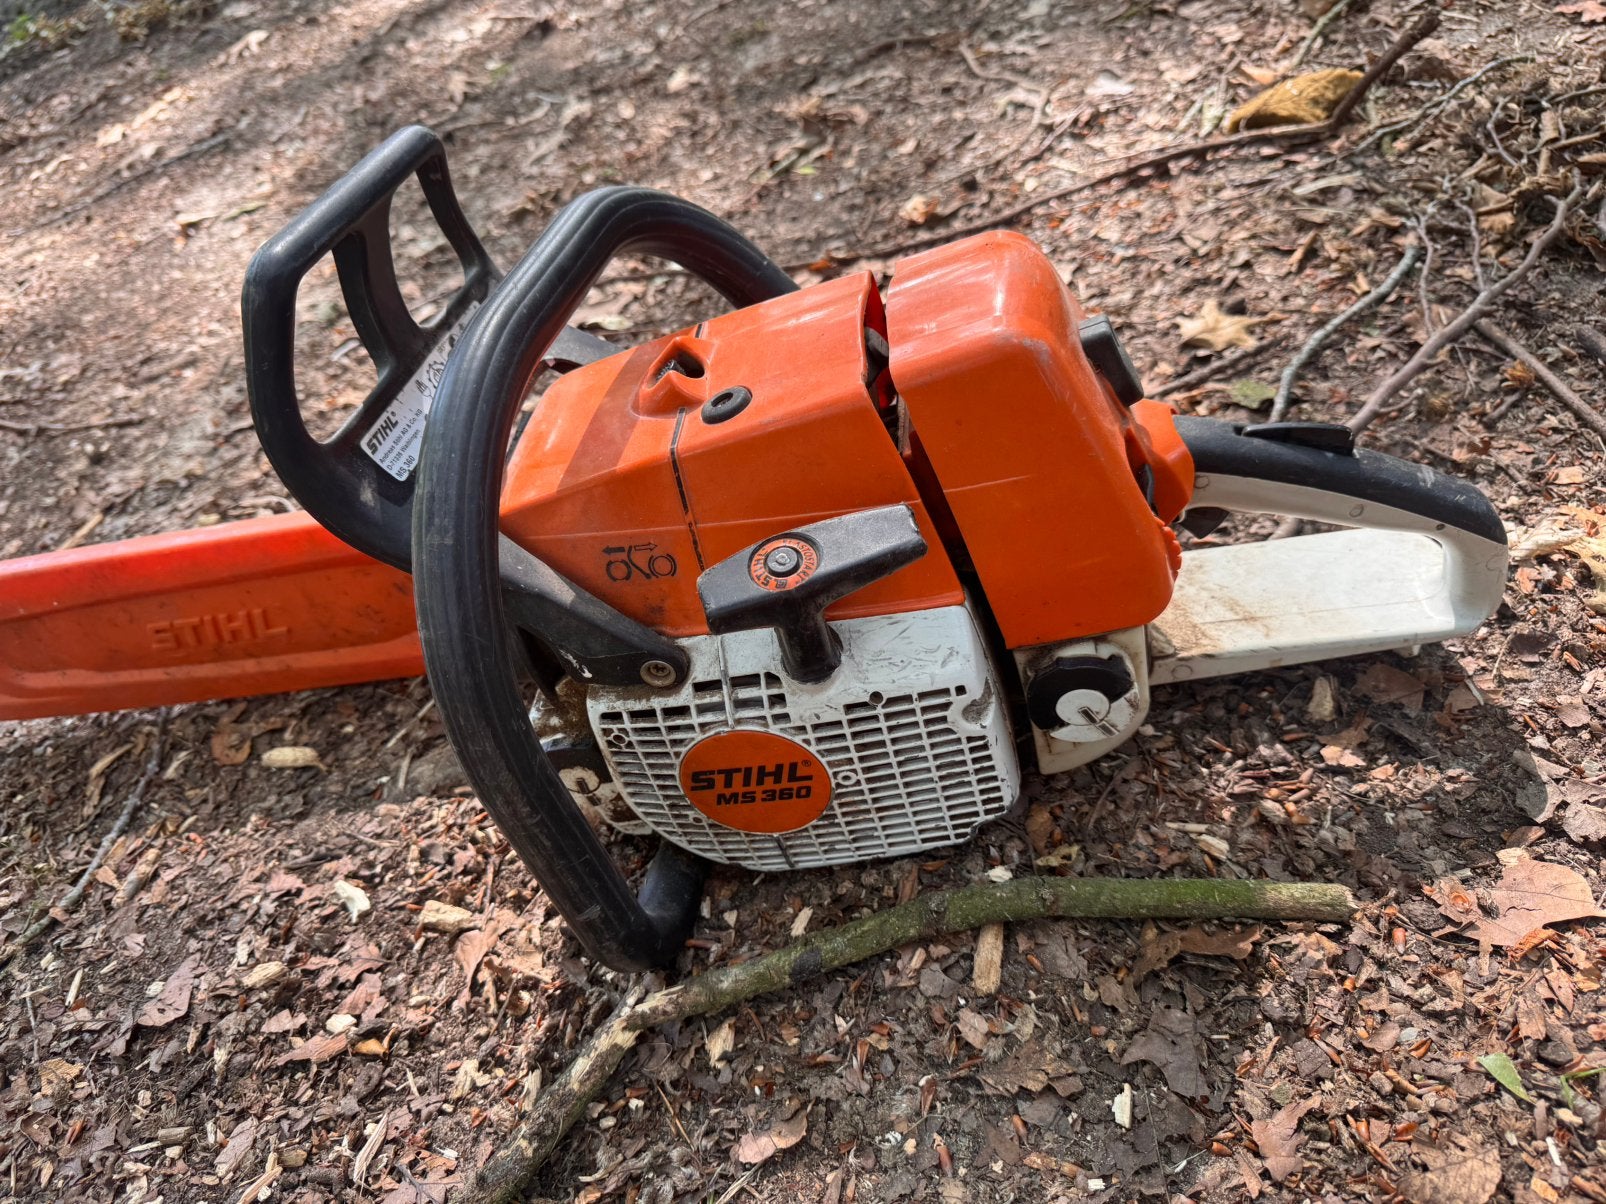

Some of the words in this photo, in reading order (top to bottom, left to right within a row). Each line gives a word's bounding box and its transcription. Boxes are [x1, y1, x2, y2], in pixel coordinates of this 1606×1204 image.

[379, 445, 396, 464] Andreas
[400, 427, 409, 437] AG
[415, 409, 423, 417] KG
[396, 466, 407, 478] MS
[403, 455, 416, 468] 360
[147, 608, 290, 648] STIHL
[716, 791, 757, 806] MS
[761, 786, 812, 802] 360
